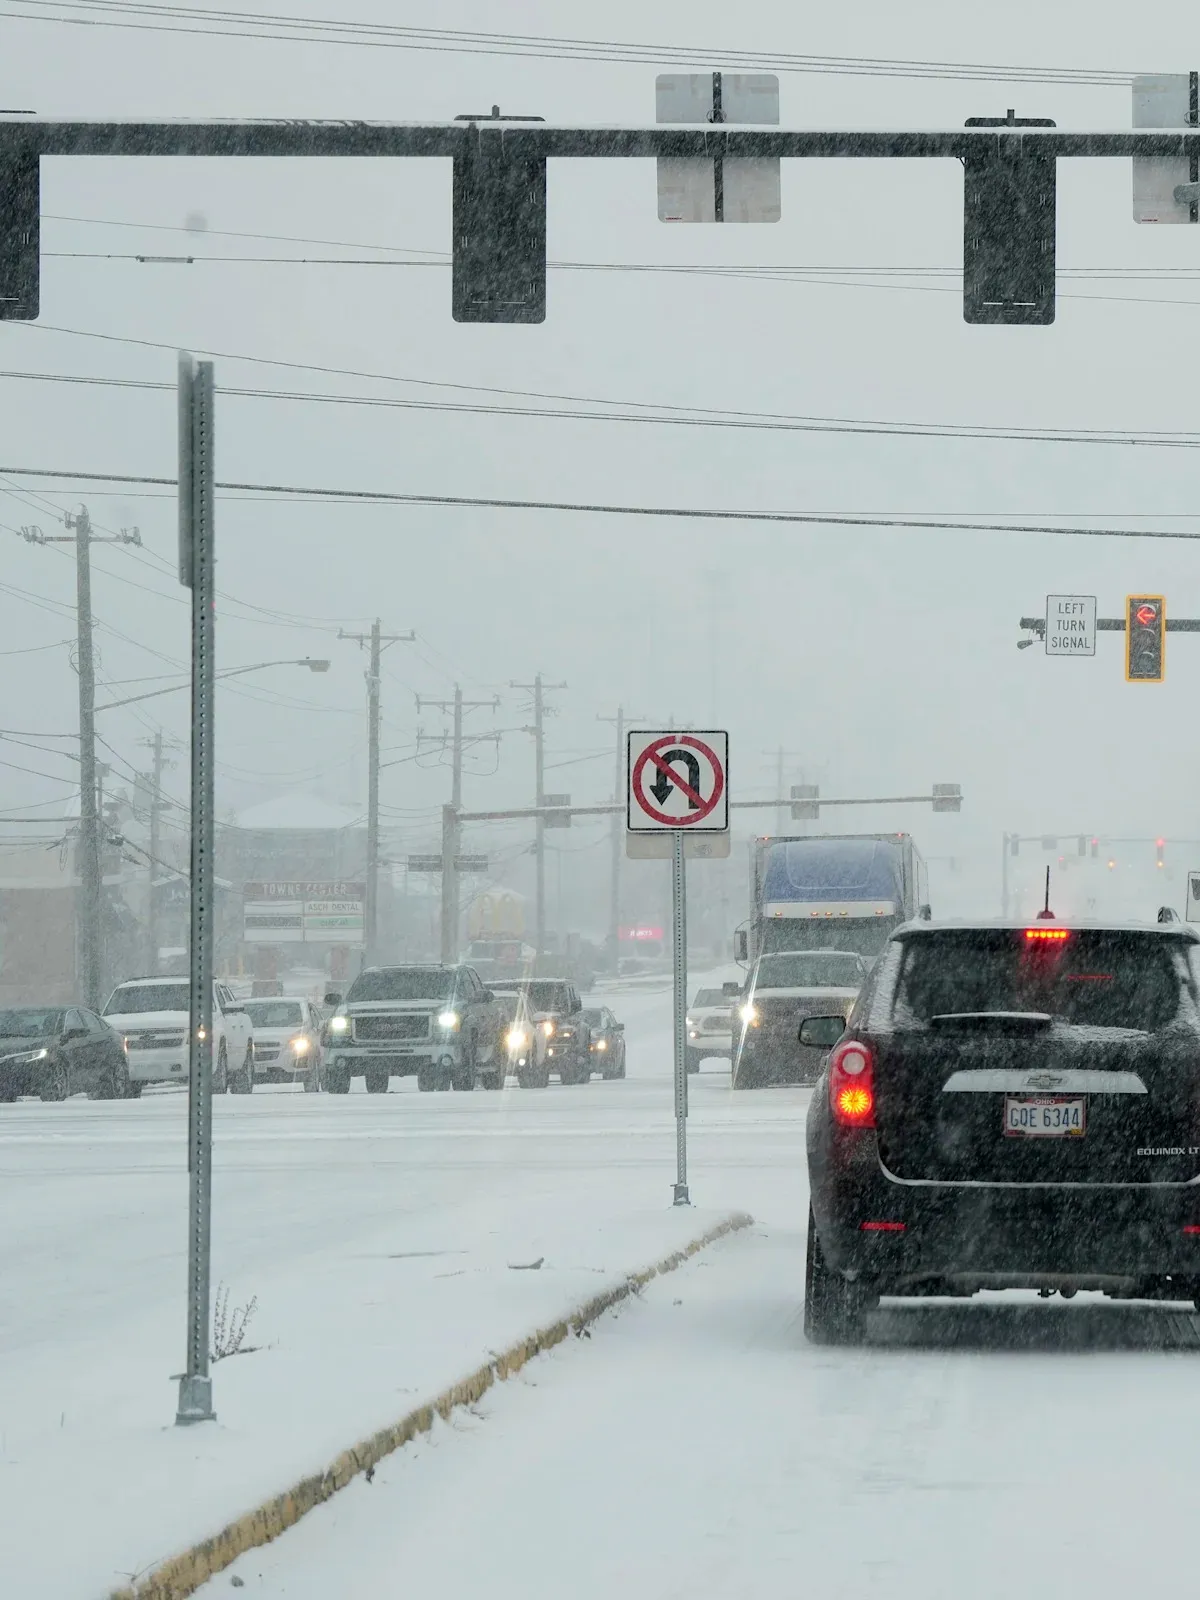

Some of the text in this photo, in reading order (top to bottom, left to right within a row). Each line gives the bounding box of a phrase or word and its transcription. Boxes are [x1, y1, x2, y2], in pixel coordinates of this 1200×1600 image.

[1058, 603, 1085, 614] LEFT
[1057, 620, 1085, 631] TURN
[1051, 636, 1090, 648] SIGNAL
[262, 883, 348, 896] TOWNE CENTER
[331, 903, 360, 911] DENTAL
[1043, 1107, 1080, 1128] 6344
[1137, 1146, 1200, 1156] EQUINOX LT
